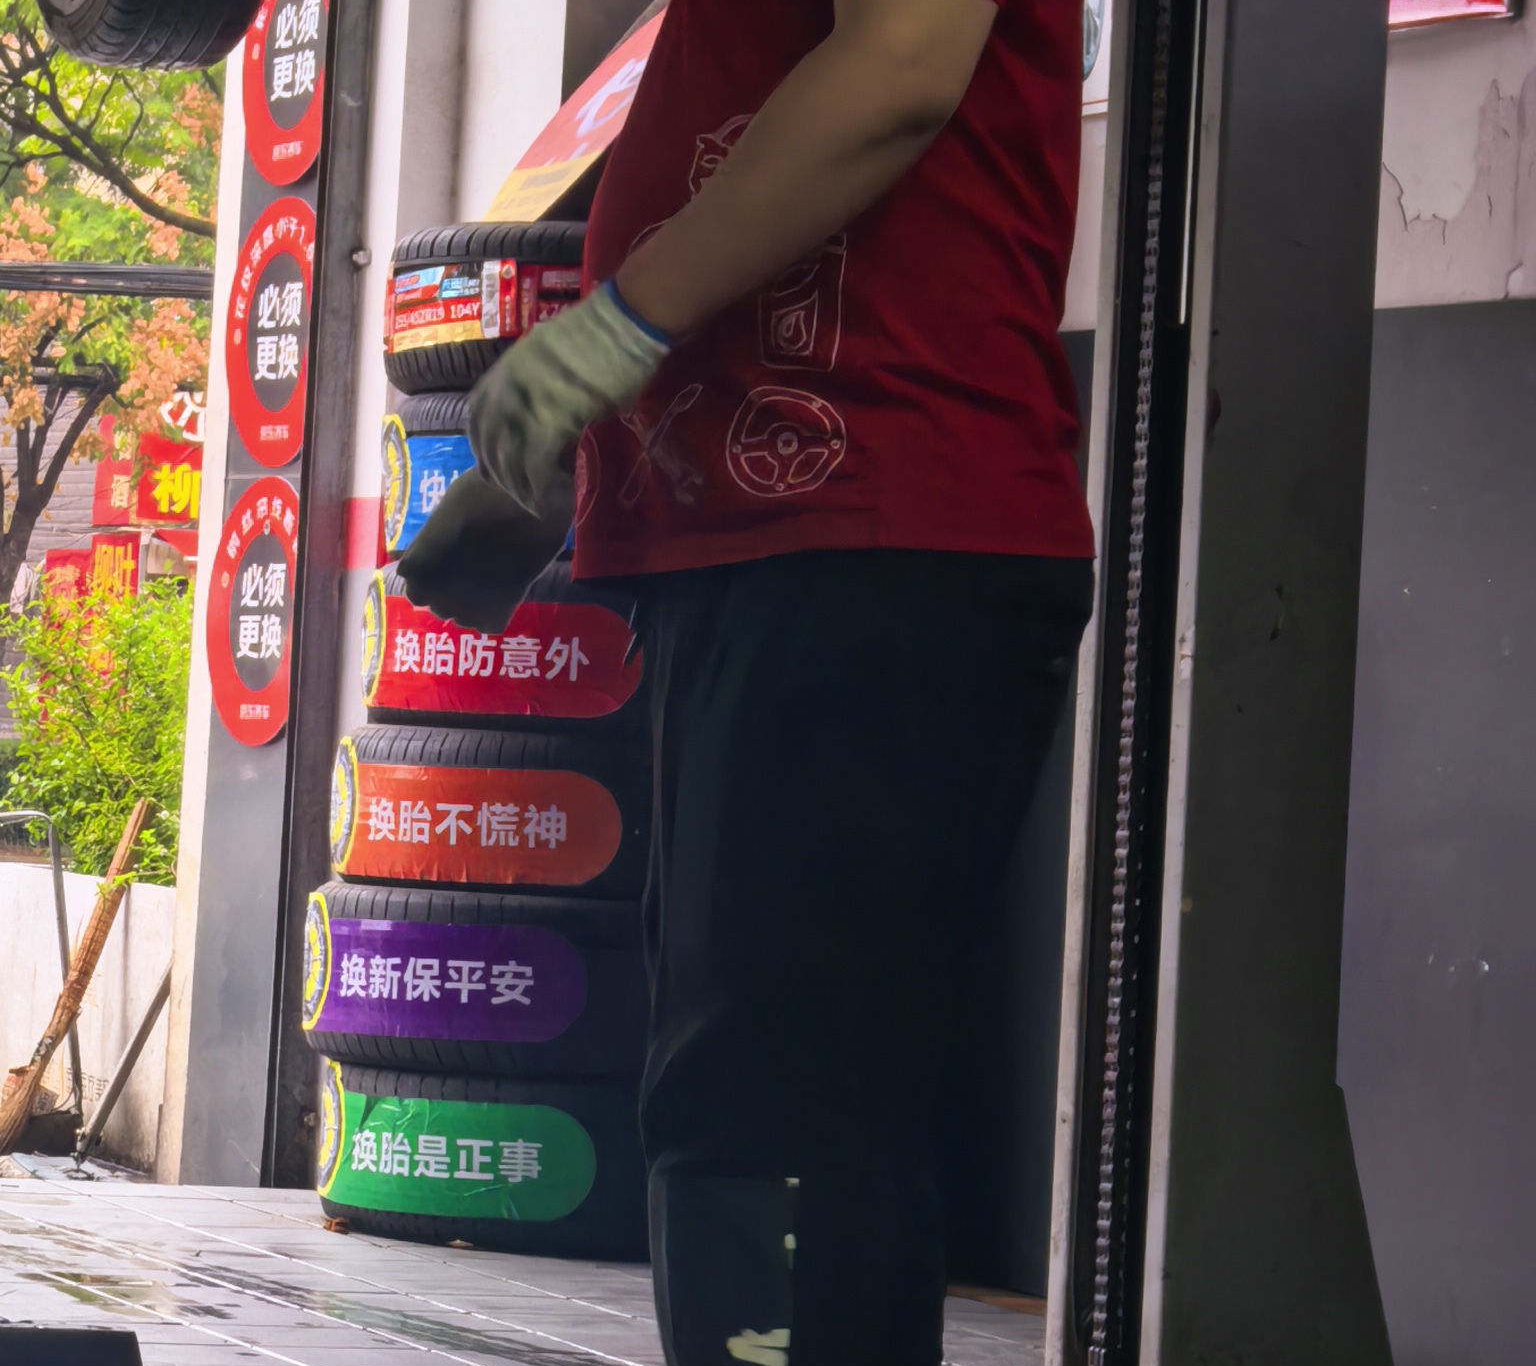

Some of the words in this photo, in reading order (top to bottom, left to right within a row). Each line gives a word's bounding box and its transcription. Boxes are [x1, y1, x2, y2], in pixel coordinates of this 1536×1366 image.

[270, 49, 317, 102] 更换
[257, 281, 304, 330] 必须
[253, 333, 299, 381] 更换
[240, 562, 287, 608] 必须
[236, 613, 282, 659] 更换
[394, 629, 590, 682] 换胎防意外
[368, 797, 568, 850] 换胎不慌神
[339, 952, 535, 1007] 换新保平安
[351, 1128, 544, 1184] 换胎是正事
